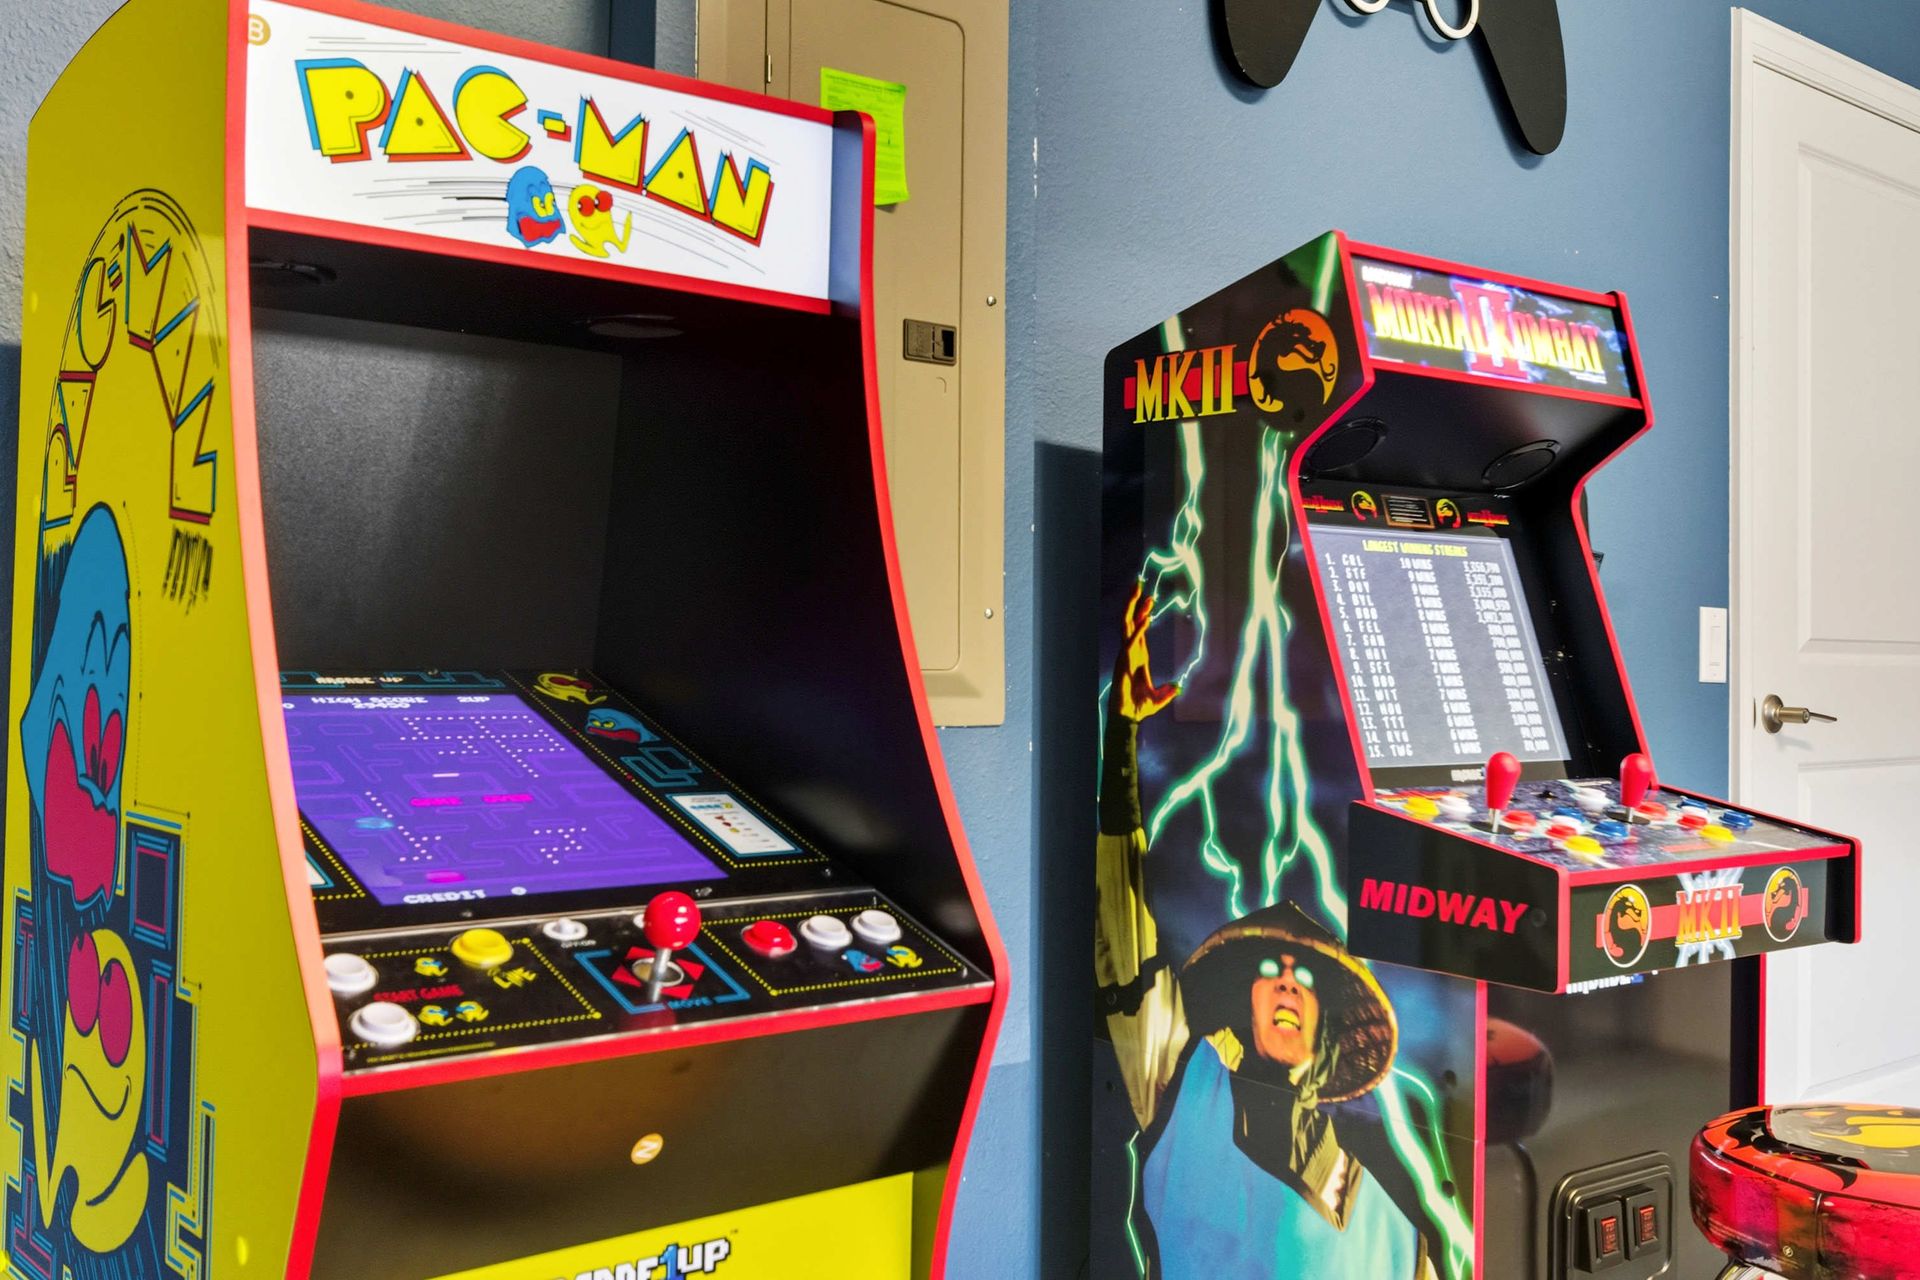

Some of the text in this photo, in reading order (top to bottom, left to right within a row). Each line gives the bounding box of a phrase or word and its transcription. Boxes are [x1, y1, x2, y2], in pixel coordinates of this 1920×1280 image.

[295, 57, 775, 247] PAC-MAN
[1133, 344, 1237, 424] MKII
[1382, 716, 1404, 729] TTT
[403, 889, 486, 904] CREDIT
[1359, 878, 1529, 934] MIDWAY
[1675, 883, 1744, 947] MKII
